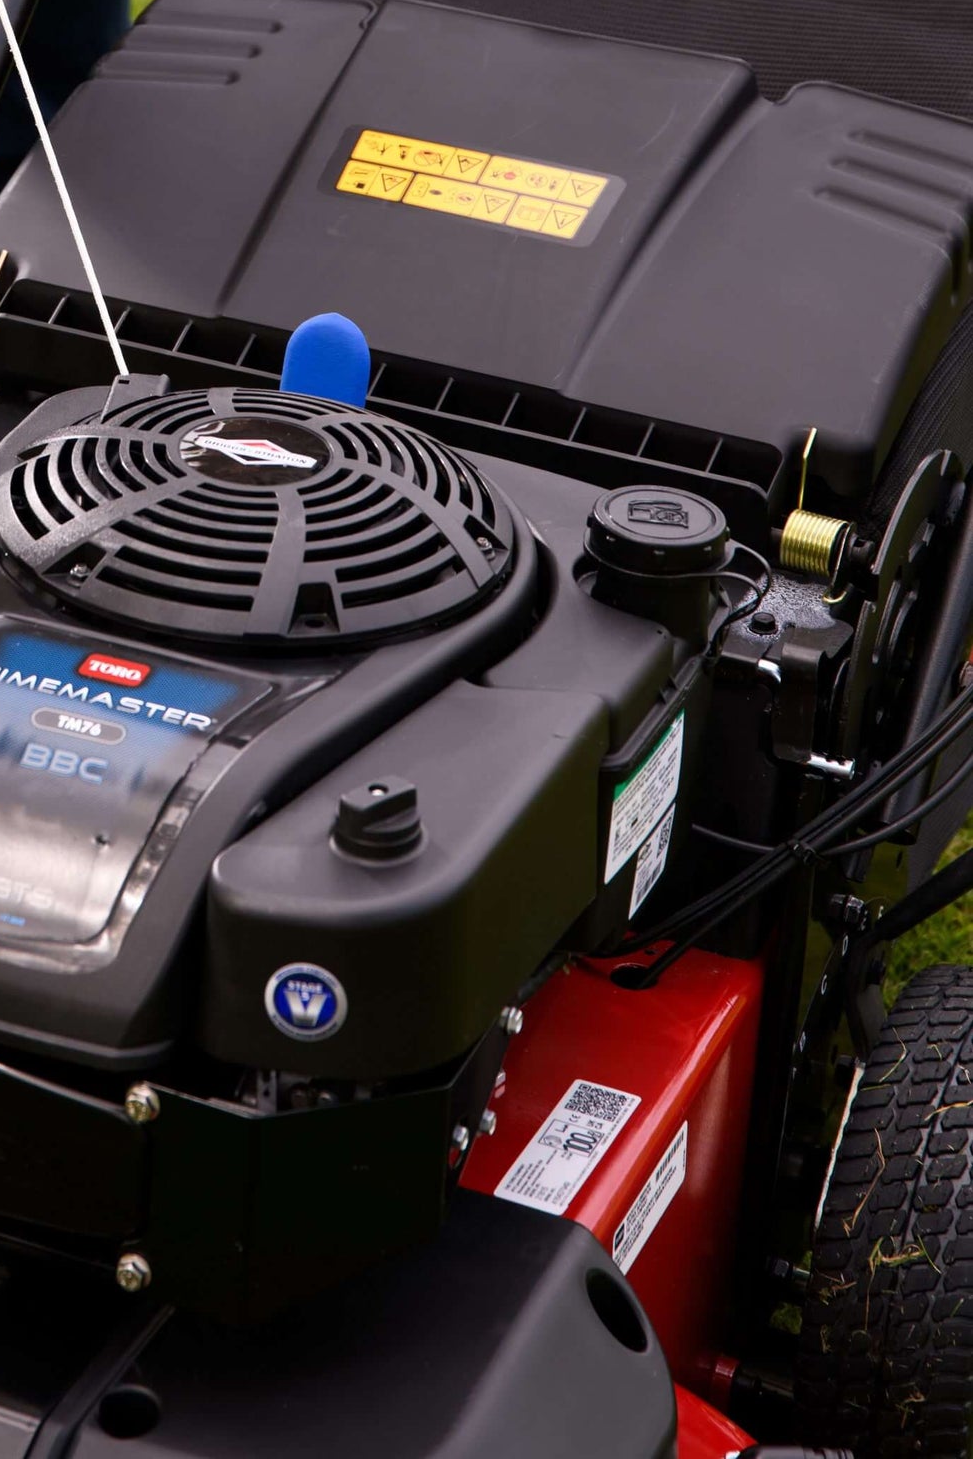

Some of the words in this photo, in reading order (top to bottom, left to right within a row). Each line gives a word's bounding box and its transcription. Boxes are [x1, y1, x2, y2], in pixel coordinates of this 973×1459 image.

[88, 659, 142, 682] TORO
[56, 713, 102, 738] TM76
[19, 742, 109, 785] BBC
[563, 1132, 598, 1154] 100
